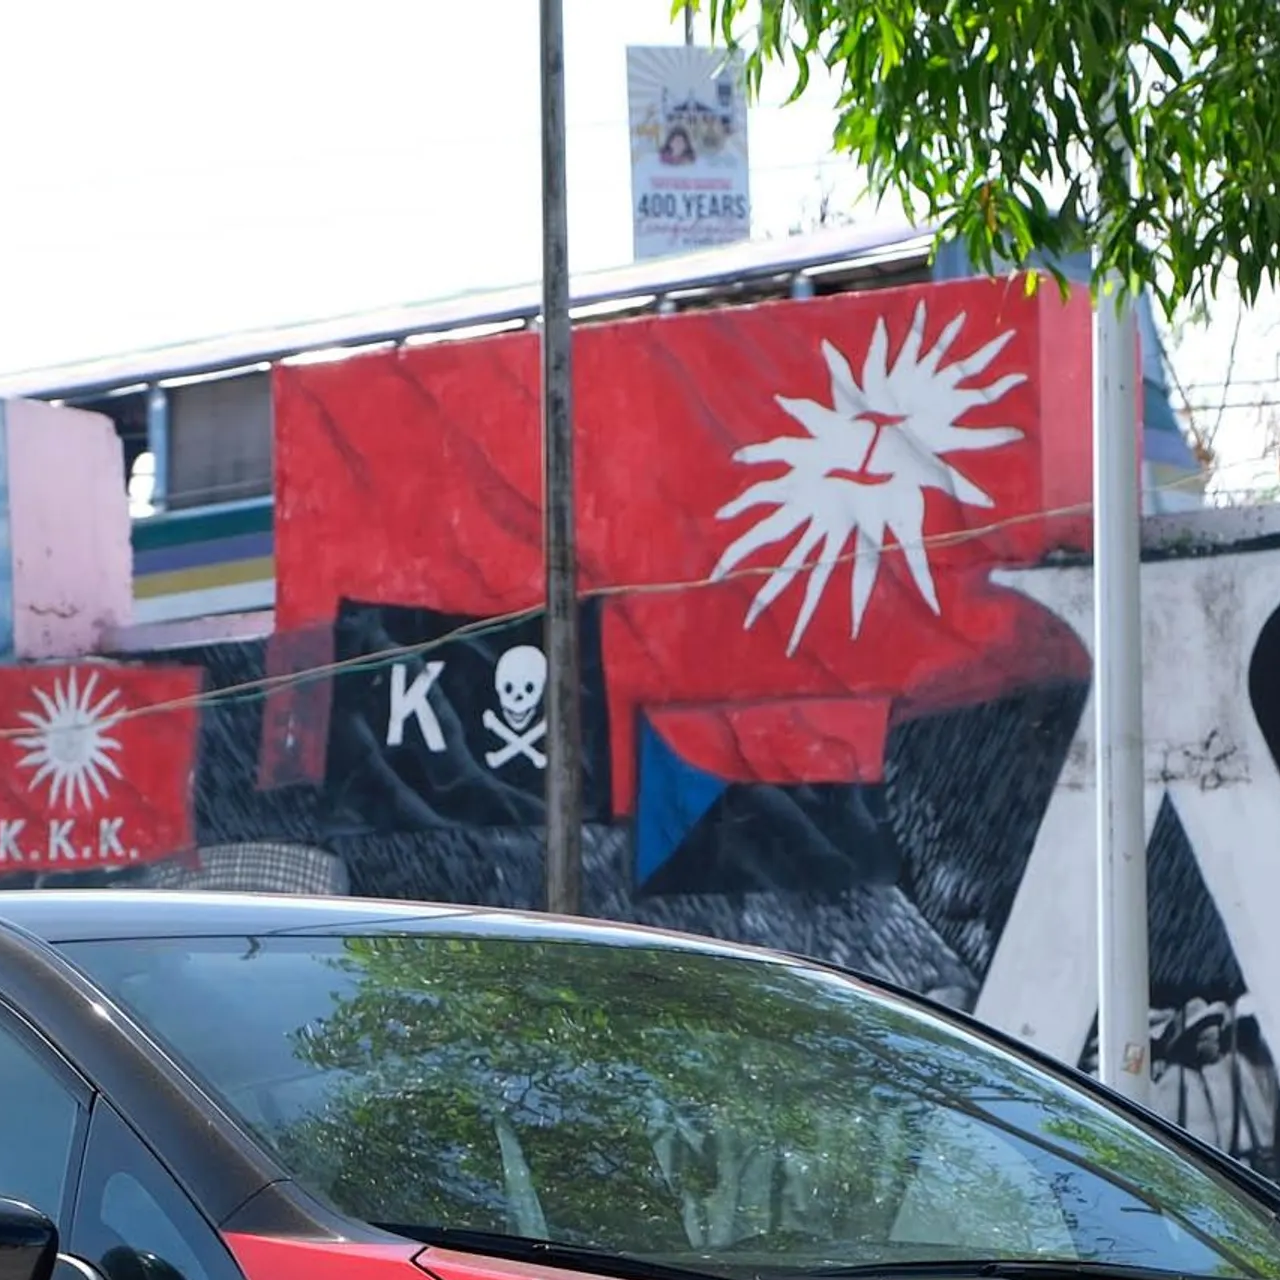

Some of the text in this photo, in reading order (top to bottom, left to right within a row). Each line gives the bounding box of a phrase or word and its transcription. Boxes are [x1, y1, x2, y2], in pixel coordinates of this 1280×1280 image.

[638, 193, 747, 219] 400 YEARS
[386, 660, 447, 752] K
